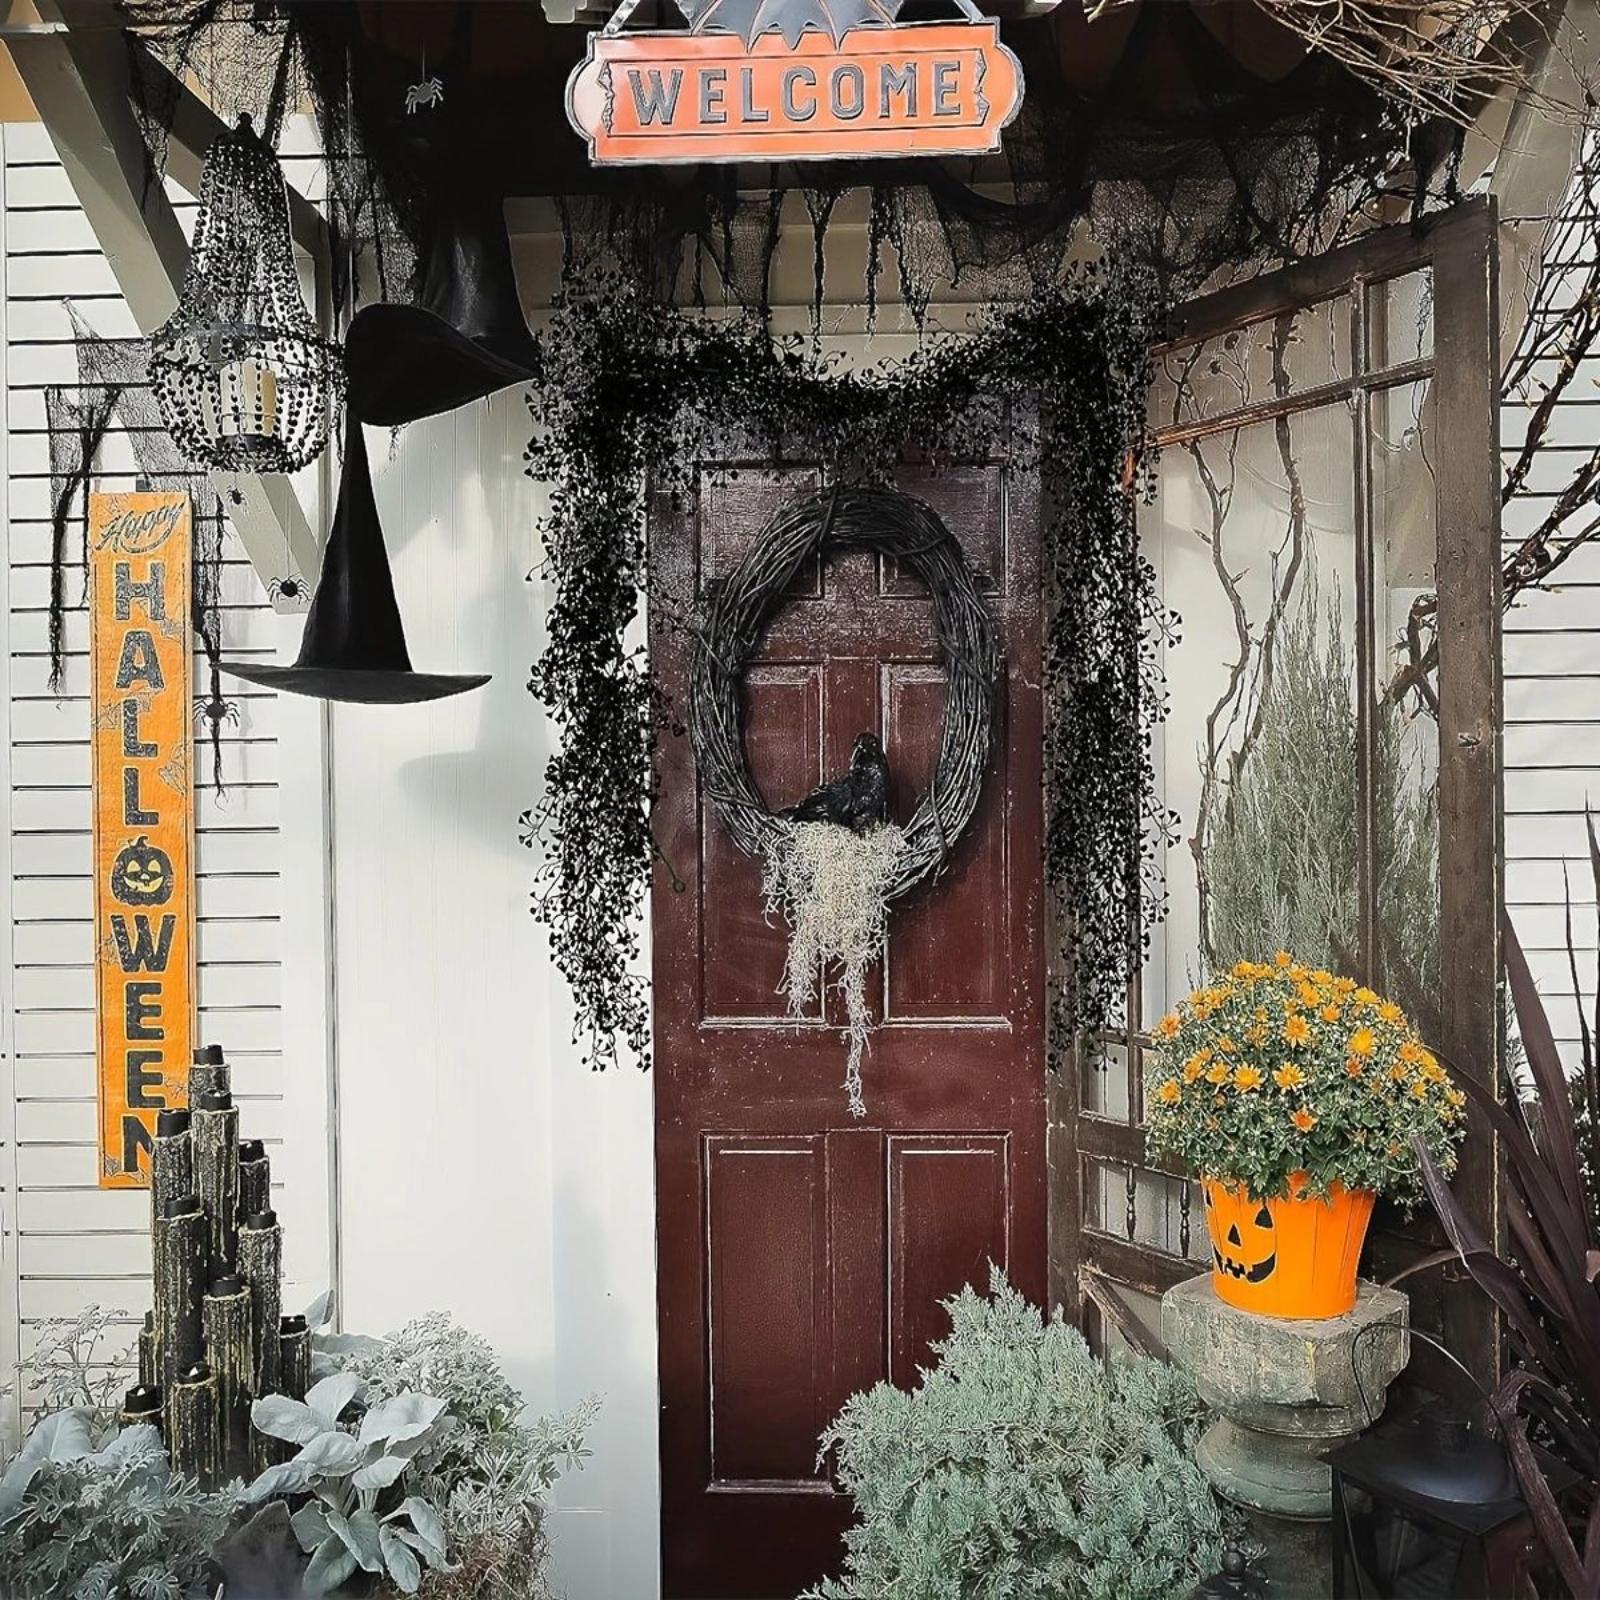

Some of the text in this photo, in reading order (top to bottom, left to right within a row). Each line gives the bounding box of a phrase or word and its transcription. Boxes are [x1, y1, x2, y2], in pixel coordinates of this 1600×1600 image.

[627, 61, 961, 126] WELCOME
[94, 501, 185, 554] Happy
[111, 562, 177, 1172] HALLOWEEN
